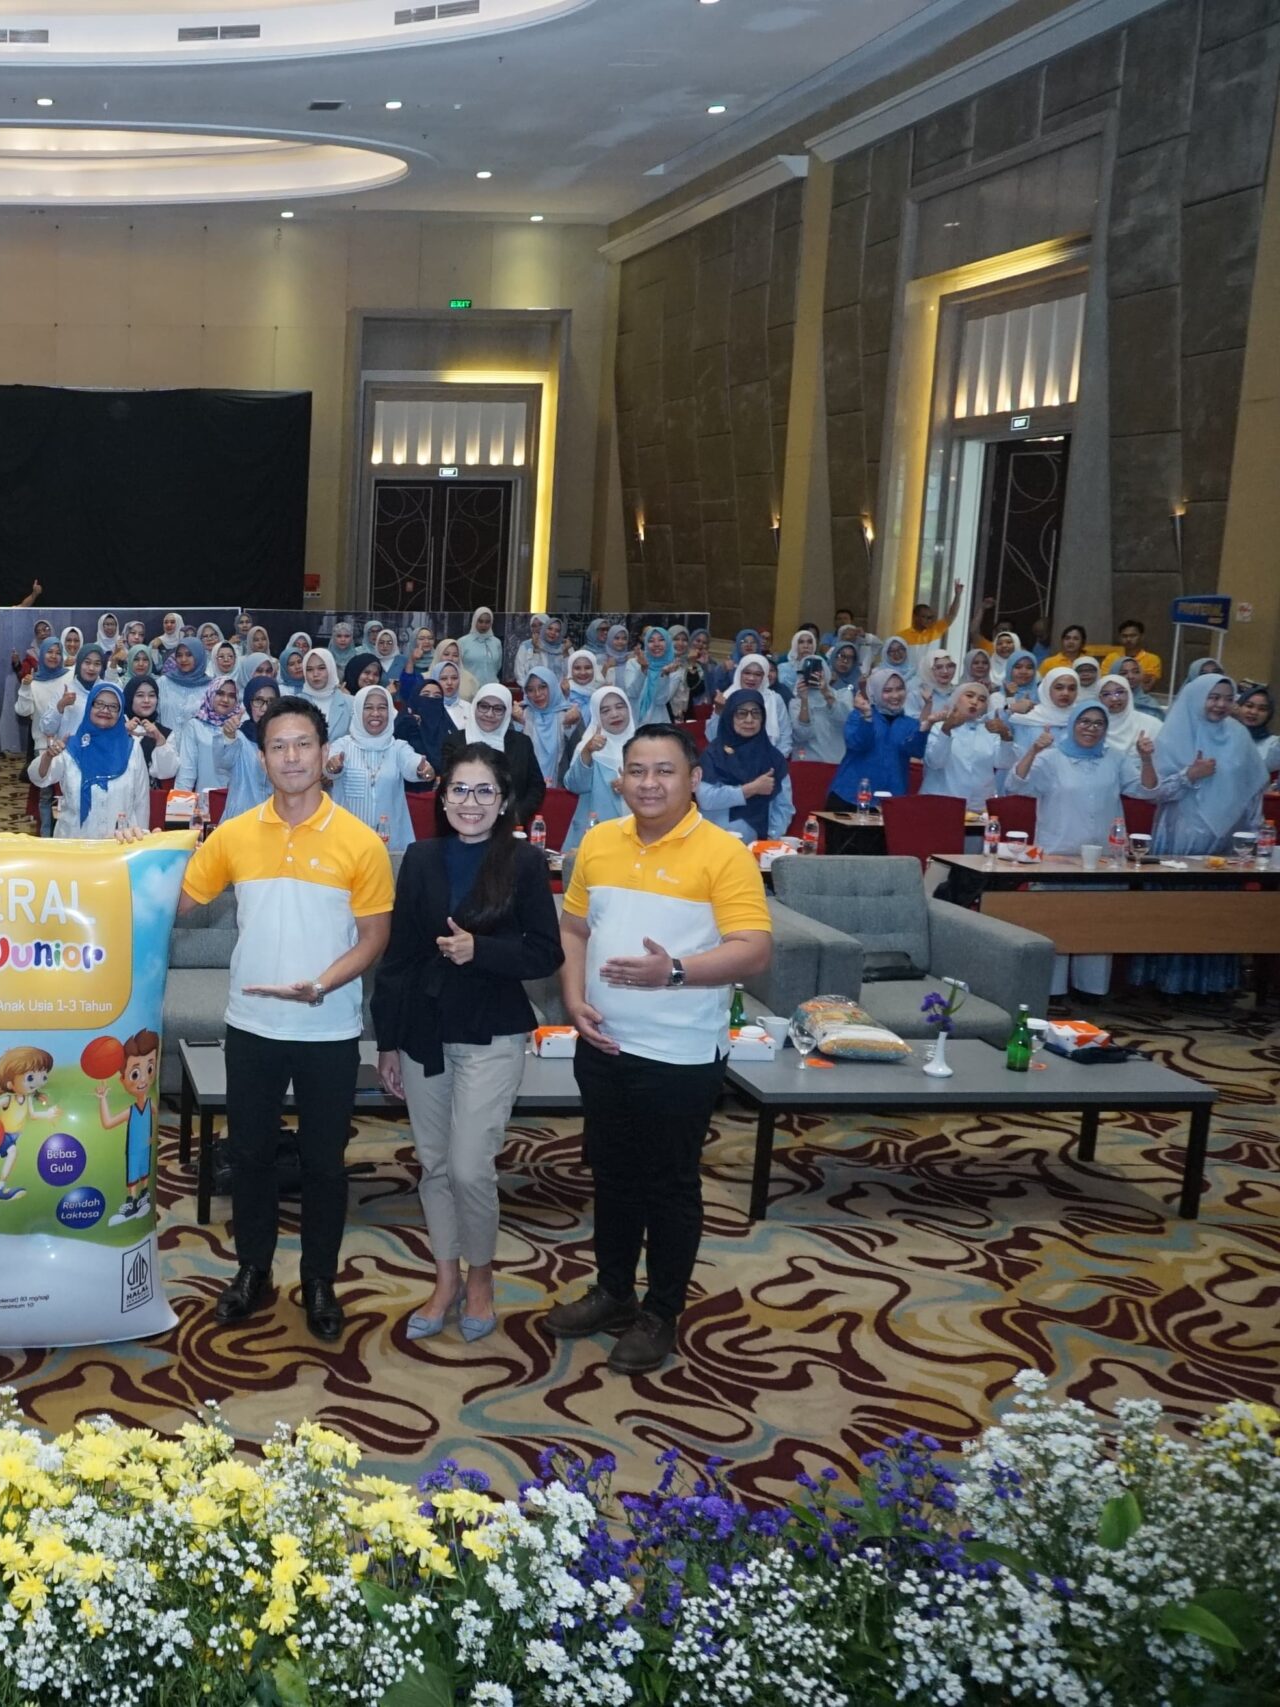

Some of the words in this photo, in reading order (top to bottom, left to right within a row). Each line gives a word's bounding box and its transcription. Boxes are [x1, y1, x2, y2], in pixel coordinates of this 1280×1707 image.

[450, 300, 470, 308] EXIT
[28, 999, 54, 1013] Usia
[58, 1000, 77, 1013] 1-3
[80, 1000, 113, 1013] Tahun
[46, 1149, 77, 1160] Bebas
[50, 1163, 74, 1173] Gula
[62, 1198, 100, 1210] Rendah
[61, 1210, 100, 1220] Laktosa
[126, 1284, 149, 1301] HALAL
